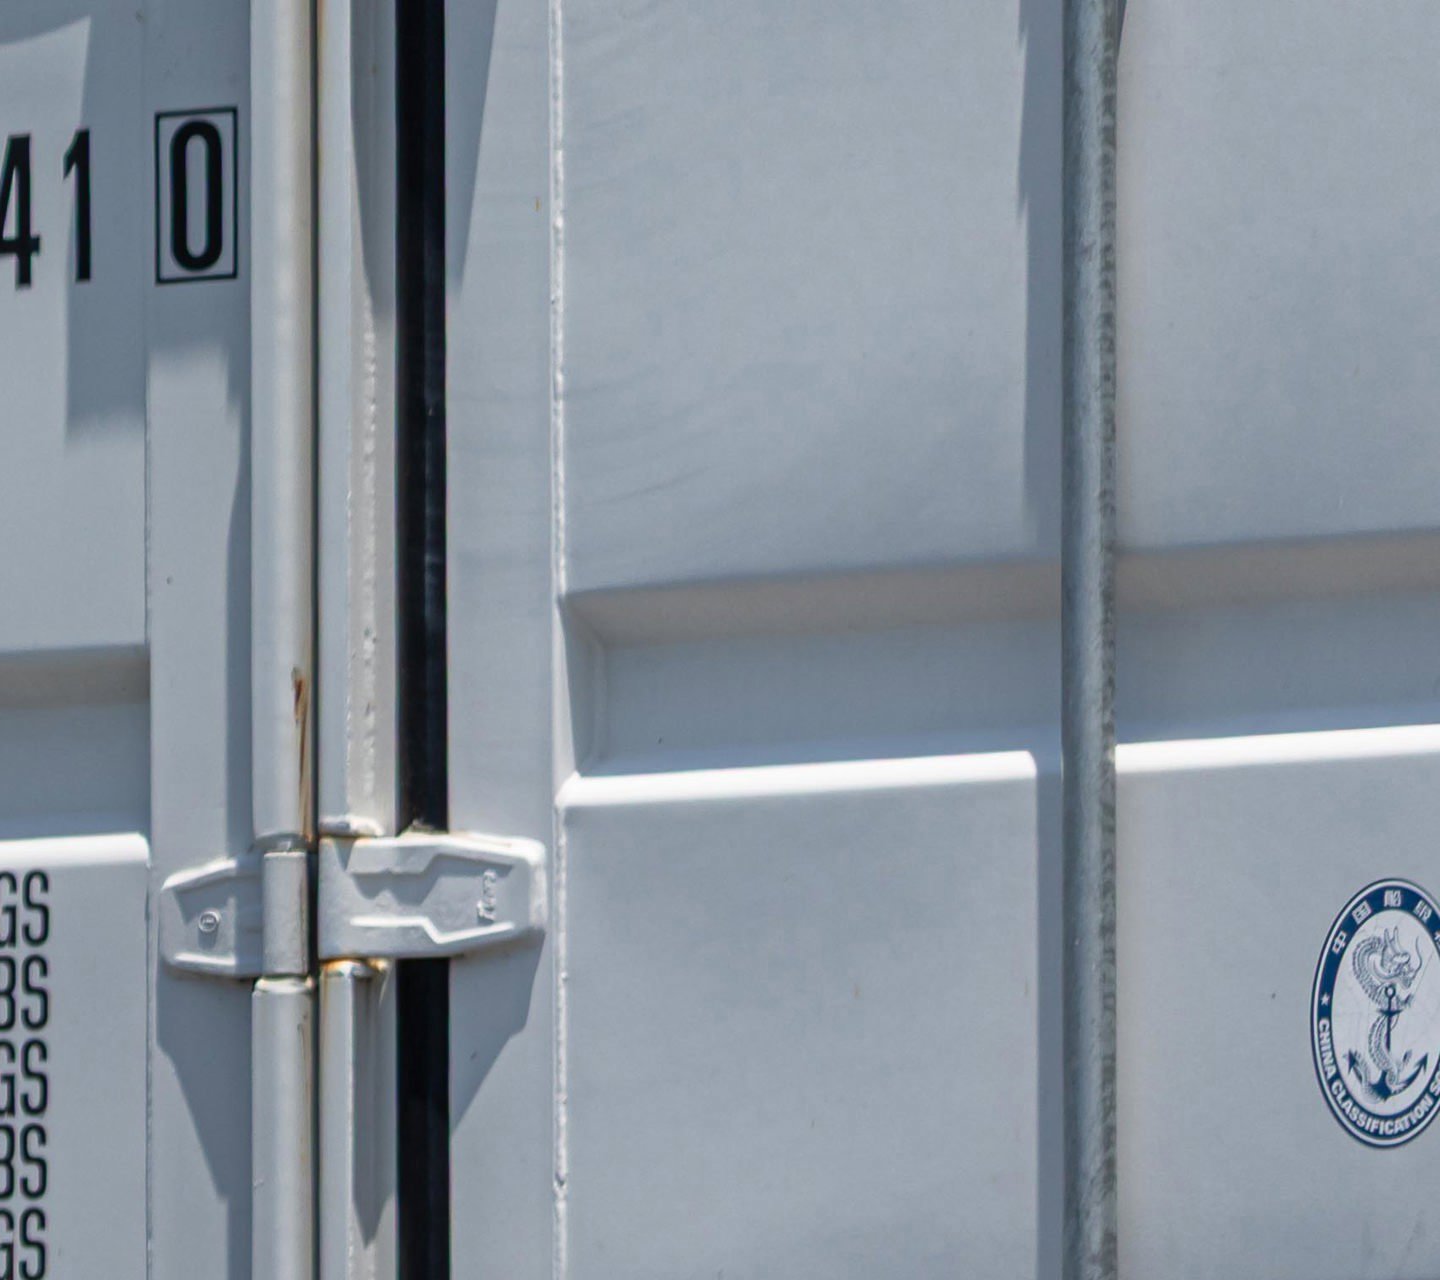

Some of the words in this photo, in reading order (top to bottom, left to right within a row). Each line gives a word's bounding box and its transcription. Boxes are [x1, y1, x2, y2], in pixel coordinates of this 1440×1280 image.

[172, 120, 222, 271] 0
[1318, 1019, 1337, 1079] CHINA
[1331, 1080, 1434, 1136] CLASSIFICATION
